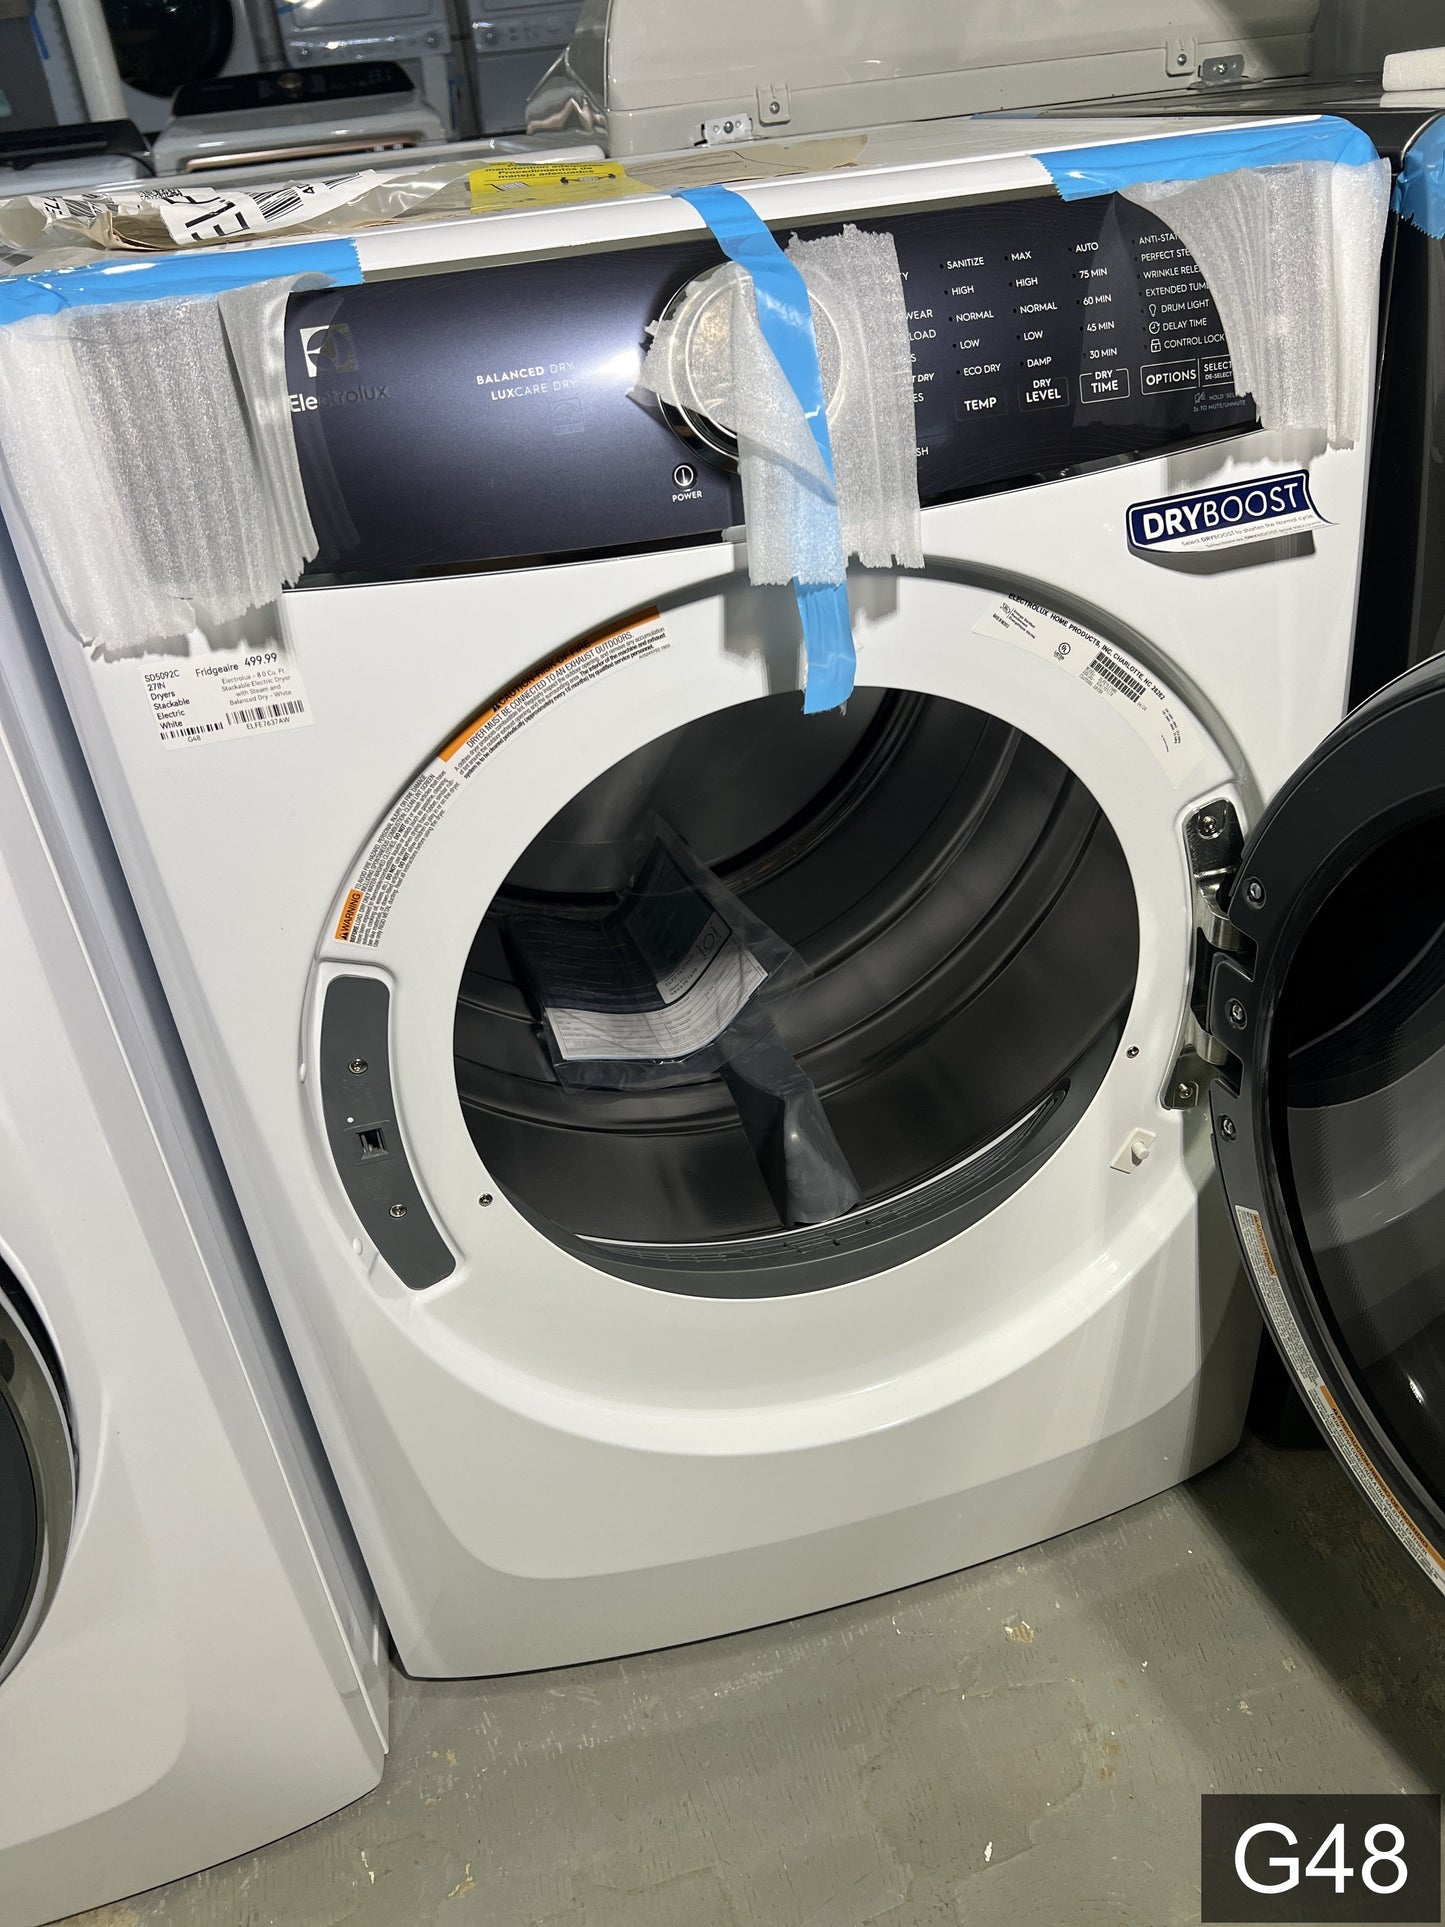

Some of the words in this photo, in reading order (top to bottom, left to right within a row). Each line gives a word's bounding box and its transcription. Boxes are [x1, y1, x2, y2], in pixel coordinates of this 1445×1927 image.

[1076, 242, 1098, 252] AUTO
[1011, 251, 1032, 261] MAX
[1141, 250, 1174, 262] PERFECT
[946, 256, 984, 269] SANITIZE
[1079, 270, 1090, 279] 75
[1091, 268, 1108, 278] MIN
[1143, 267, 1180, 279] WRINKLE
[1016, 277, 1038, 287] HIGH
[952, 285, 974, 296] HIGH
[1146, 284, 1188, 297] EXTENDED
[1083, 296, 1094, 306] 60
[1096, 294, 1112, 304] MIN
[1161, 303, 1186, 313] DRUM
[1187, 299, 1210, 310] LIGHT
[1020, 302, 1058, 314] NORMAL
[956, 310, 994, 322] NORMAL
[1086, 322, 1097, 332] 45
[1098, 321, 1115, 330] MIN
[1162, 320, 1188, 331] DELAY
[1189, 318, 1208, 328] TIME
[1023, 330, 1043, 341] LOW
[1164, 336, 1202, 348] CONTROL
[1204, 333, 1225, 343] LOCK
[960, 339, 980, 349] LOW
[1089, 350, 1100, 359] 30
[1101, 348, 1117, 358] MIN
[1026, 356, 1052, 368] DAMP
[1204, 361, 1232, 372] SELECT
[476, 366, 544, 385] BALANCED
[550, 362, 573, 374] DRY
[964, 366, 982, 376] ECO
[984, 363, 1001, 374] DRY
[1095, 370, 1113, 380] DRY
[1205, 371, 1232, 380] DE-SELECT
[918, 373, 935, 383] DRY
[1033, 378, 1052, 389] DRY
[1146, 370, 1197, 386] OPTIONS
[490, 384, 548, 400] LUXCARE
[553, 379, 576, 392] DRY
[1091, 380, 1119, 393] TIME
[1026, 388, 1062, 402] LEVEL
[964, 397, 997, 412] TEMP
[672, 490, 702, 502] POWER
[1142, 482, 1298, 540] DRYBOOST
[1201, 530, 1235, 542] DRYBOOST
[1007, 592, 1049, 616] ELECTROLUX
[1049, 612, 1068, 627] HOME
[1068, 623, 1102, 648] PRODUCTS,
[1101, 644, 1113, 655] INC.
[1112, 652, 1145, 680] CHARLOTTE,
[1142, 677, 1152, 687] NC
[1150, 685, 1165, 700] 28262
[244, 652, 277, 667] 499.99
[145, 670, 180, 682] SD5092C
[196, 664, 238, 677] Fridgeaire
[222, 675, 251, 684] Electrolux
[222, 684, 250, 692] Stackable
[251, 678, 273, 686] Electric
[147, 682, 166, 691] 27IN
[151, 691, 176, 701] Dryers
[230, 696, 256, 705] Balanced
[465, 727, 487, 748] DRYER
[484, 713, 503, 731] MUST
[500, 706, 511, 716] BE
[509, 679, 547, 710] CONNECTED
[545, 672, 556, 683] TO
[554, 666, 566, 678] AN
[564, 649, 595, 671] EXHAUST
[154, 698, 190, 710] Stackable
[157, 710, 185, 720] Electric
[160, 720, 182, 730] White
[246, 717, 290, 730] ELFE7637AW
[340, 892, 360, 932] WARNING
[1256, 1224, 1274, 1275] ADVERTENCIA
